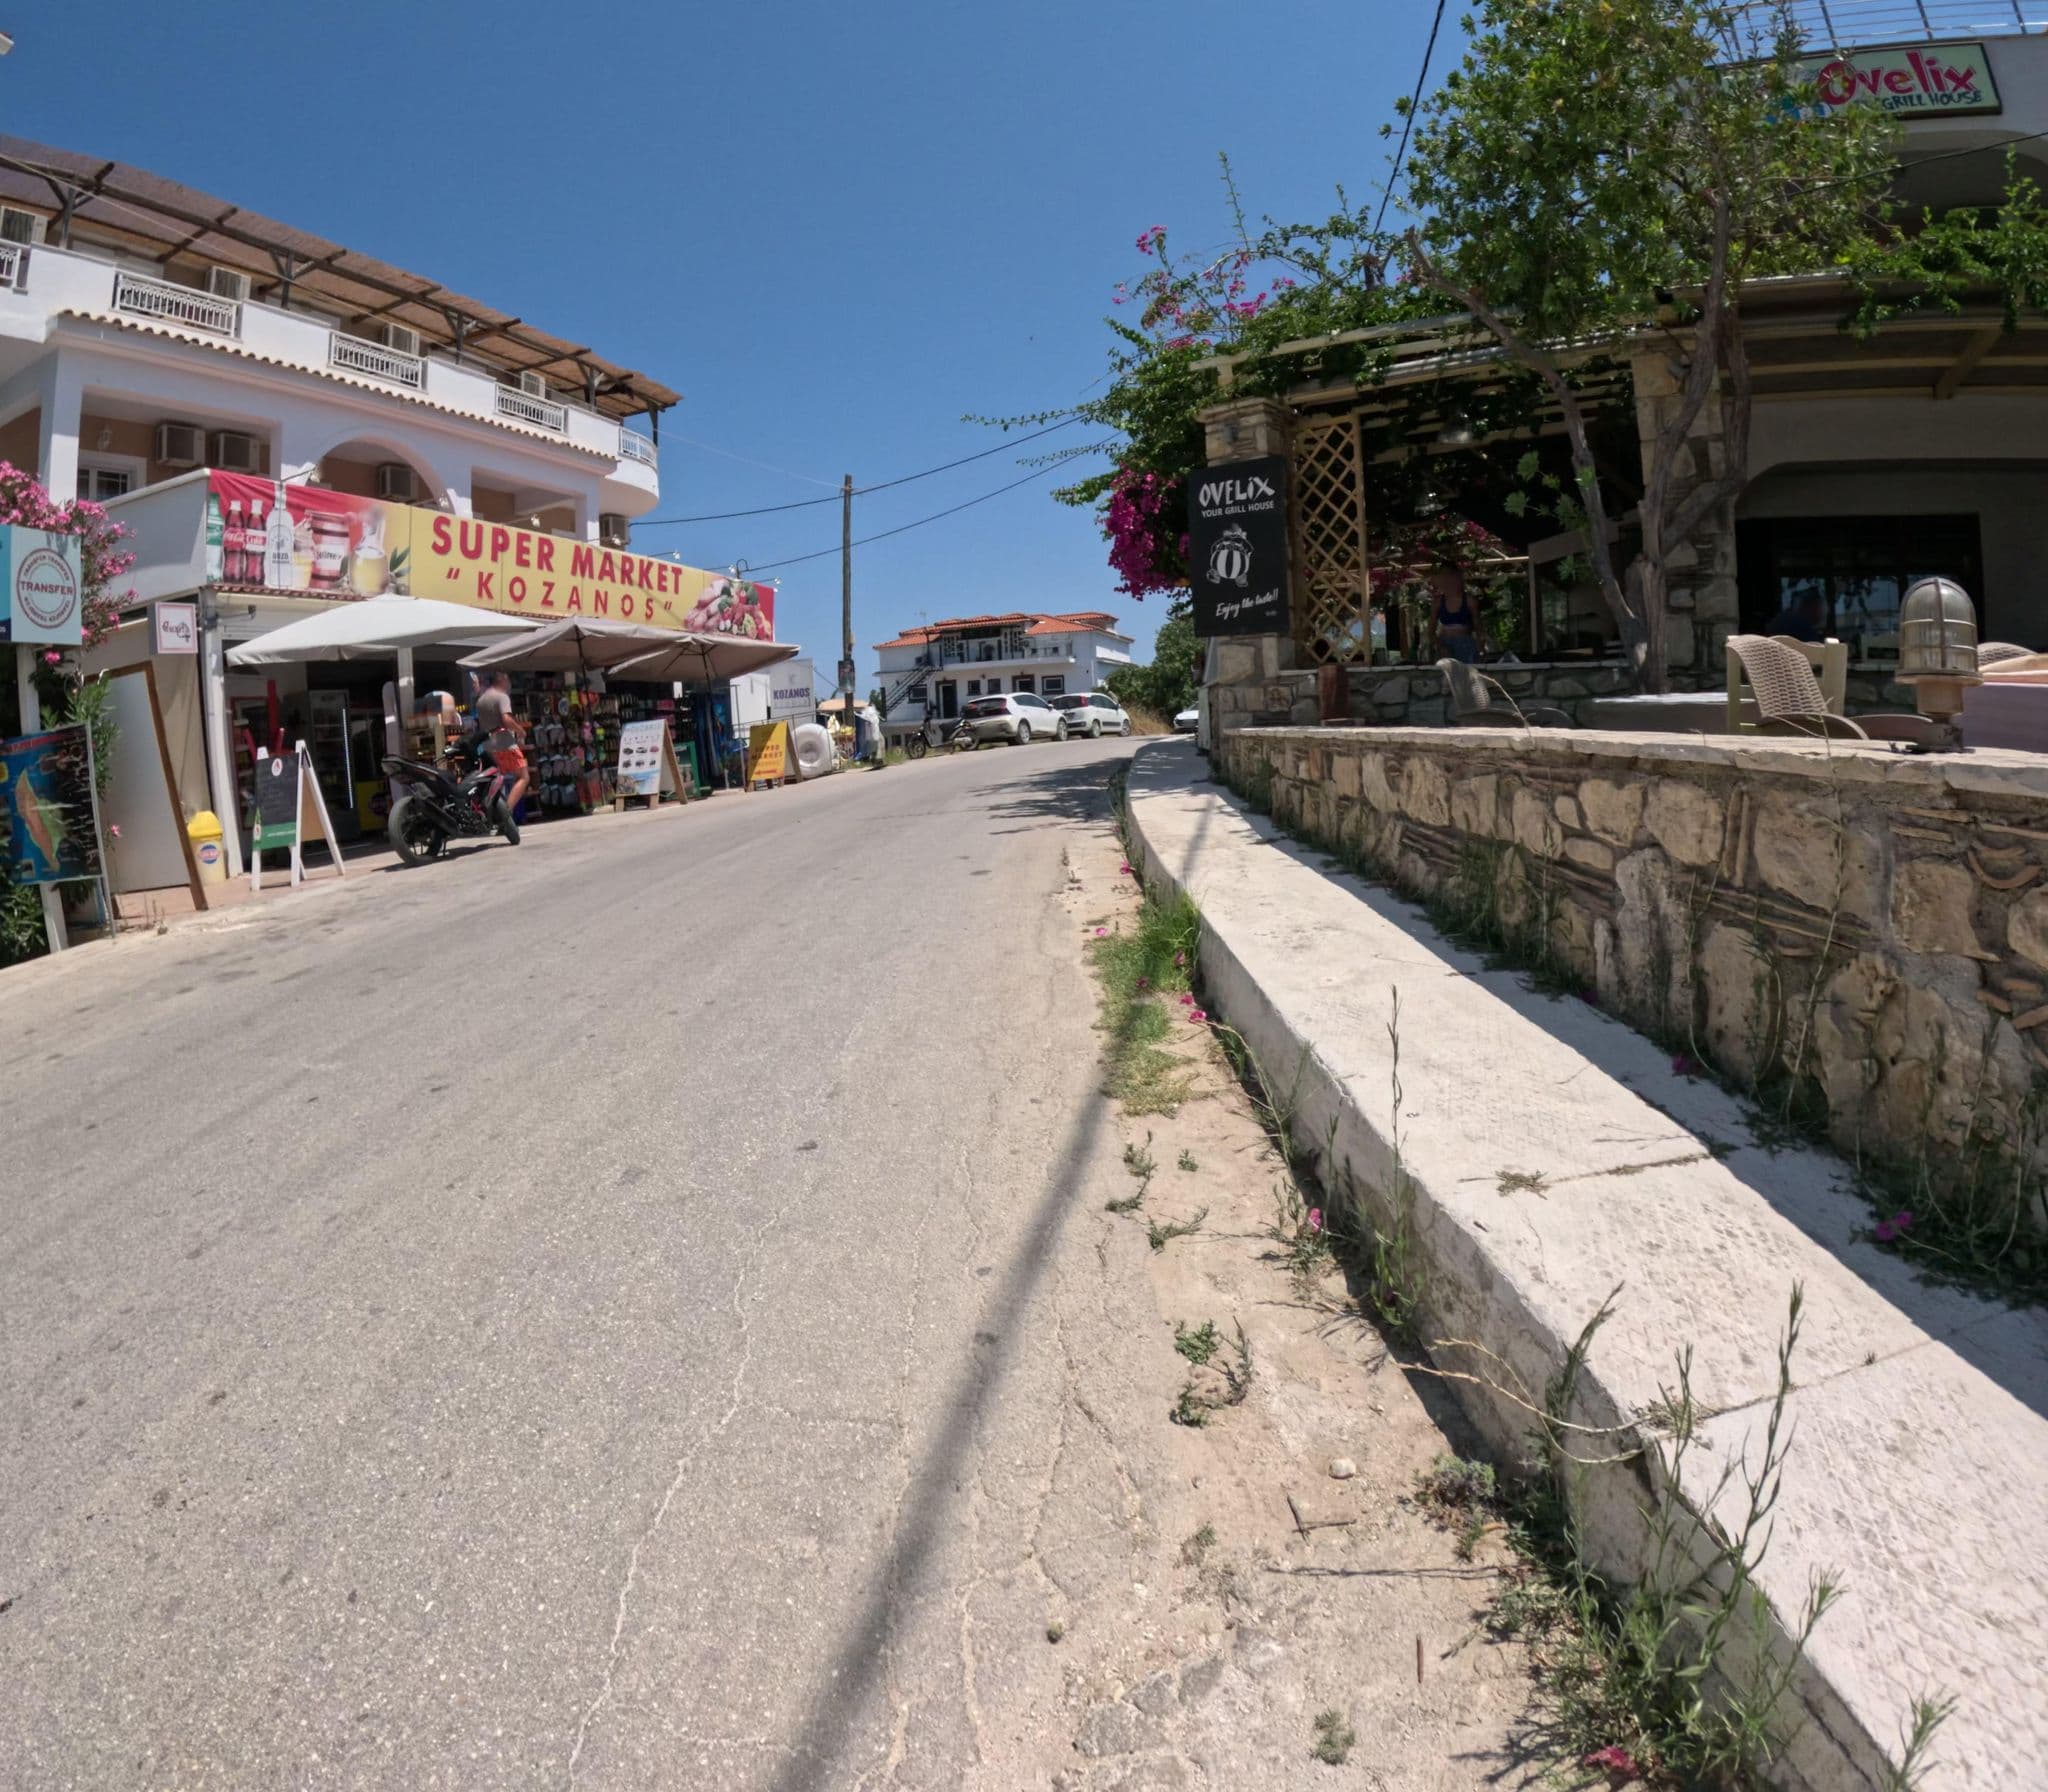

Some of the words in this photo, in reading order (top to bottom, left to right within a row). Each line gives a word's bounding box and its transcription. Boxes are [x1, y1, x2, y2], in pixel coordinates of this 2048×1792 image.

[1817, 50, 1978, 106] Ovelix
[1882, 93, 1927, 111] GRILL
[1930, 90, 1983, 106] HOUSE
[1201, 507, 1223, 518] YOUR
[1224, 504, 1246, 515] GRILL
[1248, 500, 1275, 512] HOUSE
[431, 515, 555, 573] SUPER
[570, 544, 683, 595] MARKET
[20, 580, 74, 596] TRANSFER
[1215, 602, 1241, 620] Enjoy
[1241, 597, 1254, 609] the
[773, 687, 811, 700] KOZANOS
